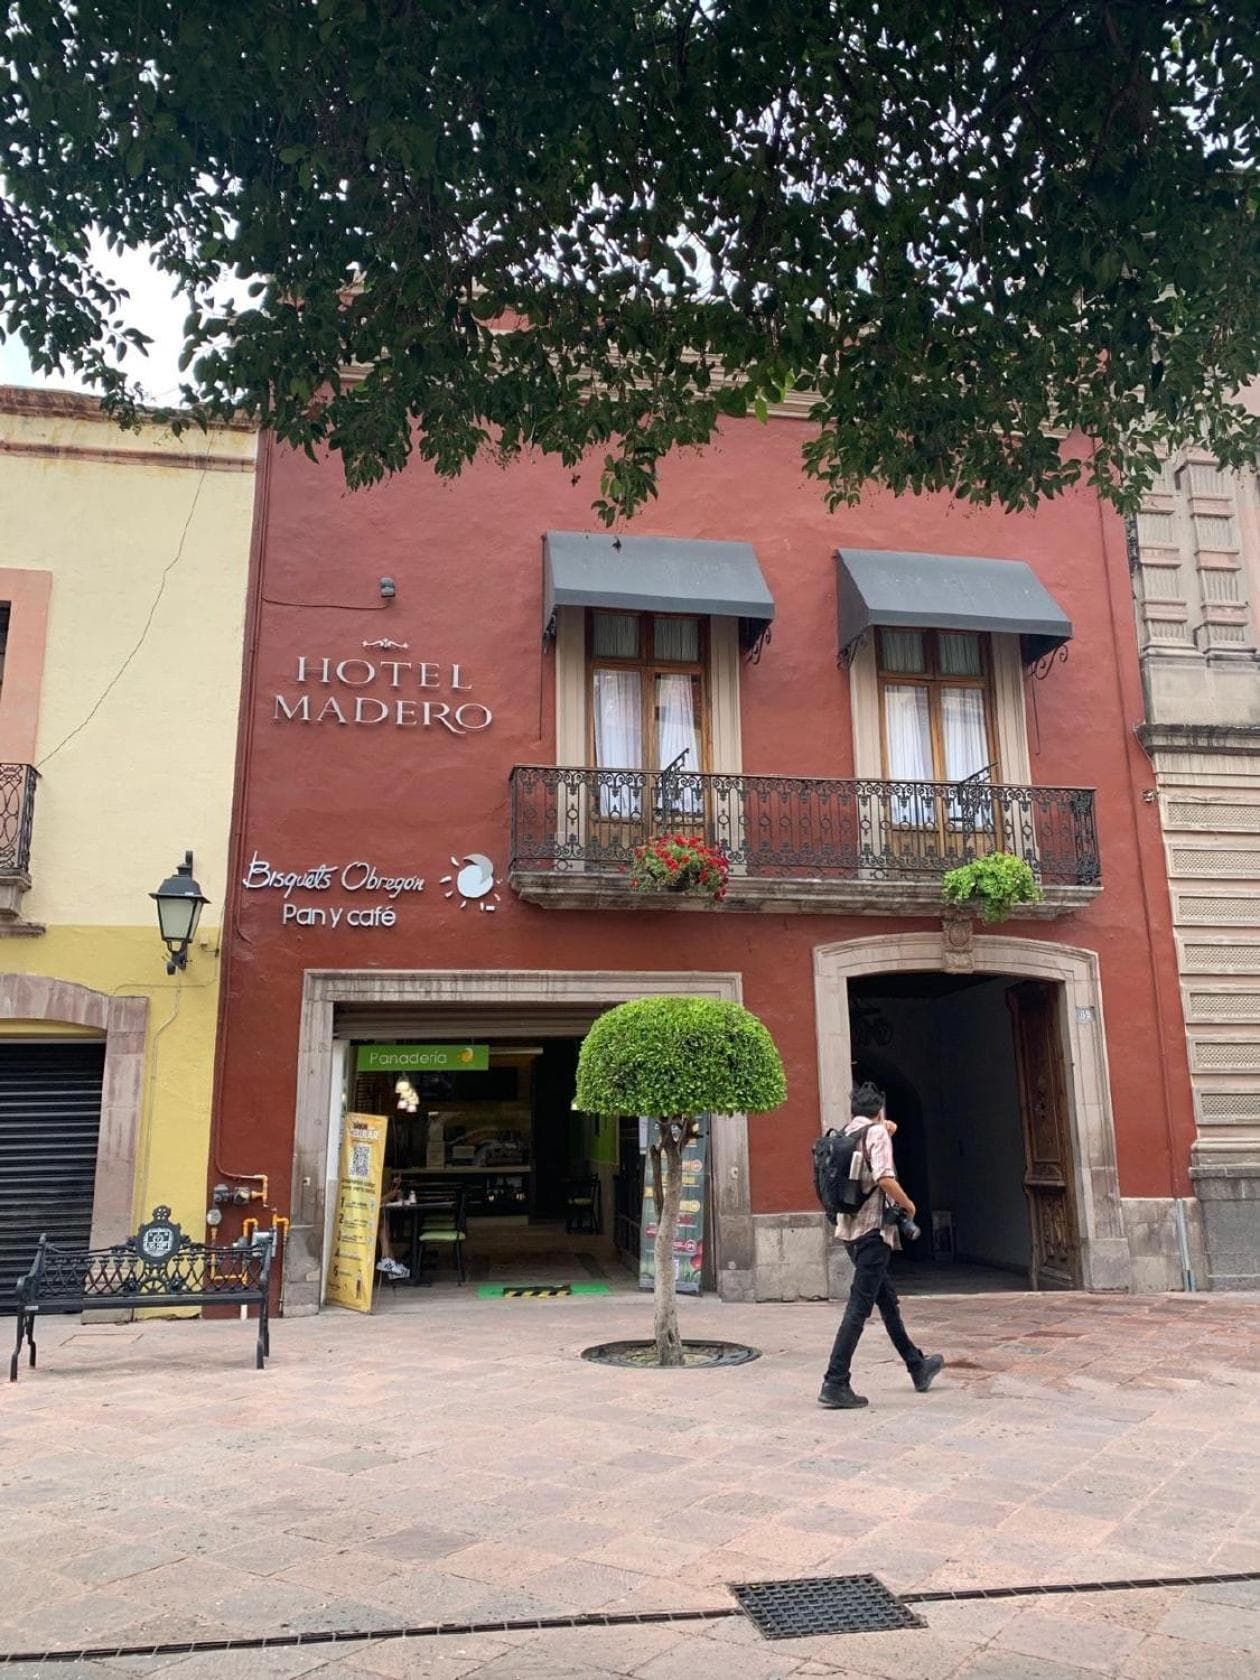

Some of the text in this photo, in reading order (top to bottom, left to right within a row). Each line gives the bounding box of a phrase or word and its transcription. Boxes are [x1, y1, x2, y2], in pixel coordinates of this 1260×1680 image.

[296, 656, 473, 690] HOTEL
[273, 695, 493, 735] MADERO
[242, 850, 339, 899] Bisquets
[282, 904, 397, 929] Pan y café
[369, 1050, 448, 1065] Panadería
[338, 1213, 344, 1224] 2
